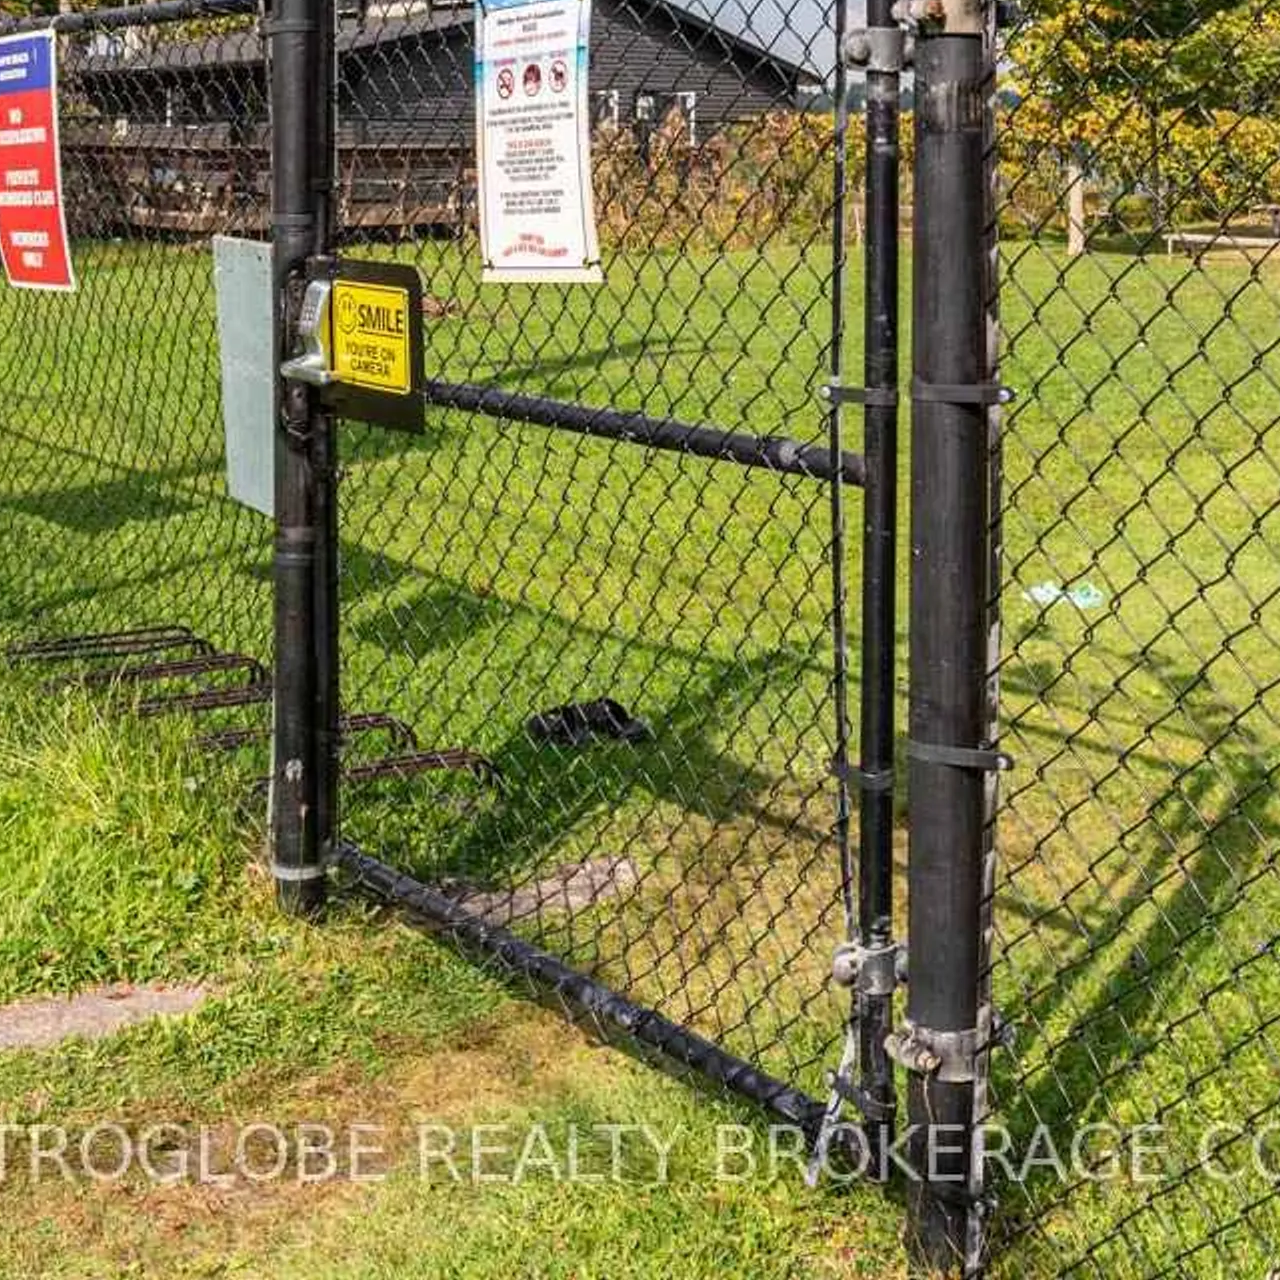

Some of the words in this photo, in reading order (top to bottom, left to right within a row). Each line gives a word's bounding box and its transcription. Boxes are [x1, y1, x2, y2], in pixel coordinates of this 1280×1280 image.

[358, 303, 404, 334] SMILE
[380, 347, 396, 364] ON
[350, 358, 391, 378] CAMERA
